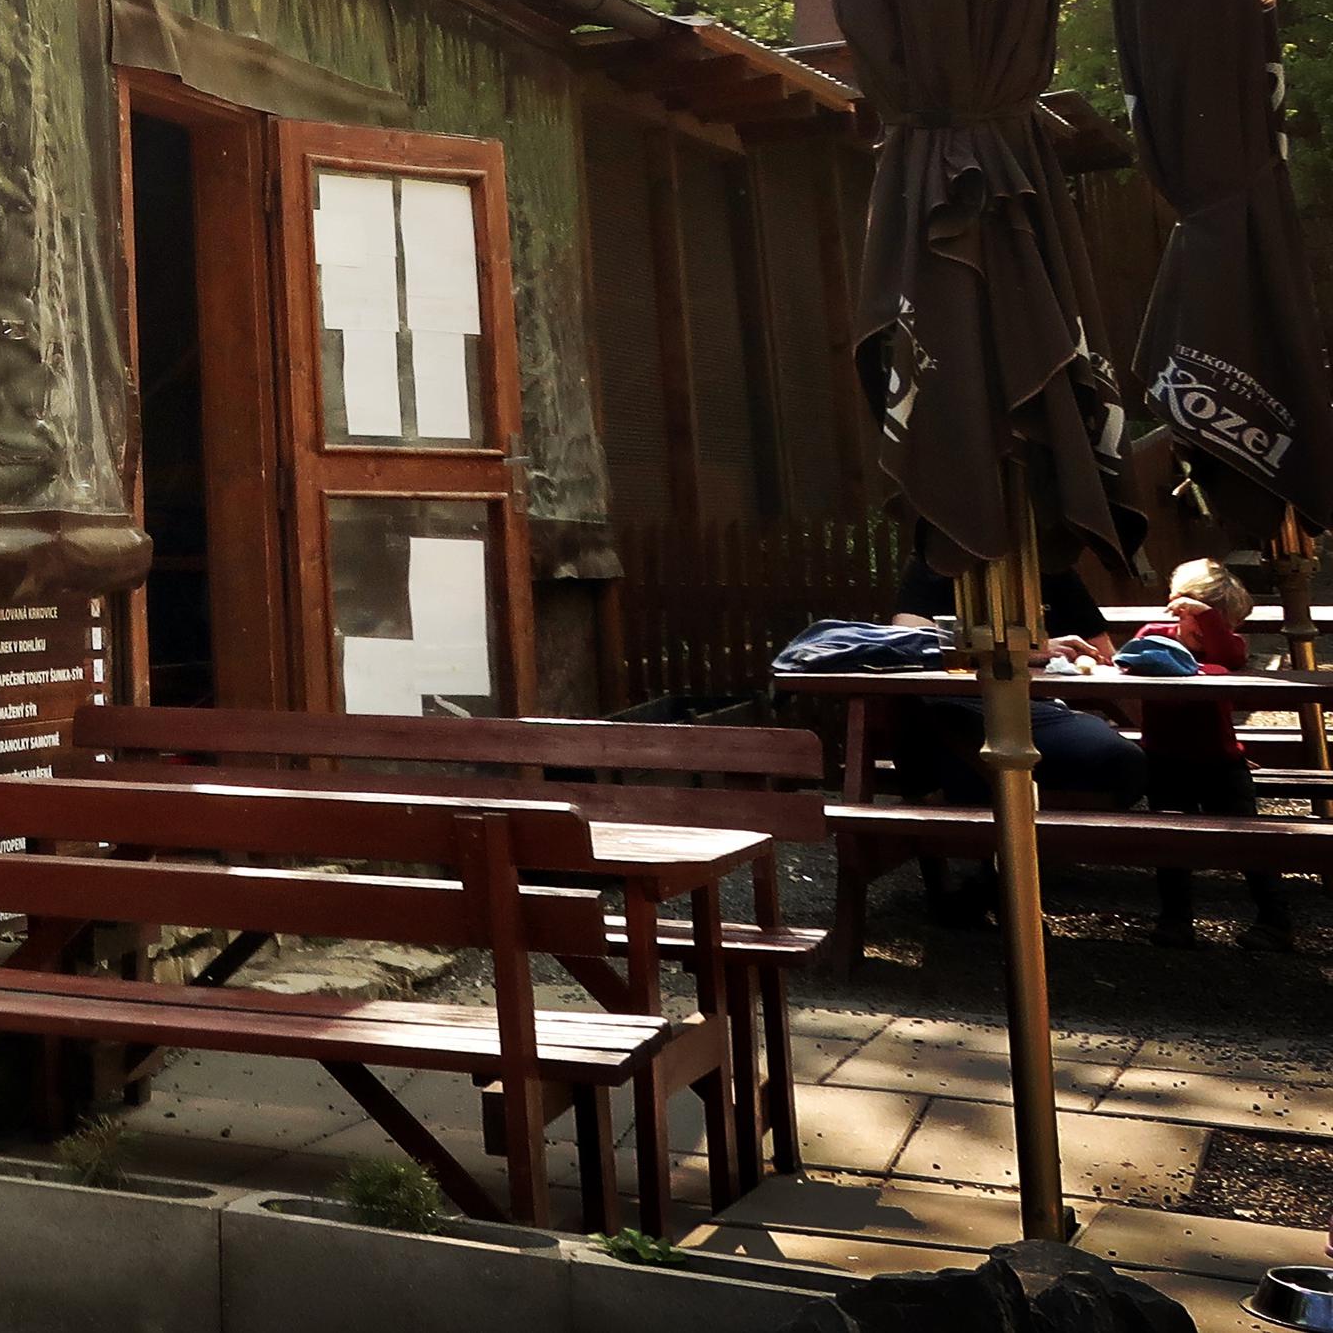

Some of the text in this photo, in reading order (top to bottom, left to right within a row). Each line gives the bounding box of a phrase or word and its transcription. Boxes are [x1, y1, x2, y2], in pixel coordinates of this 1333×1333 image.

[1146, 355, 1294, 470] Kozel
[18, 637, 46, 652] ROHLÍKU
[25, 670, 49, 685] TOUSTY
[24, 701, 38, 718] SÝR
